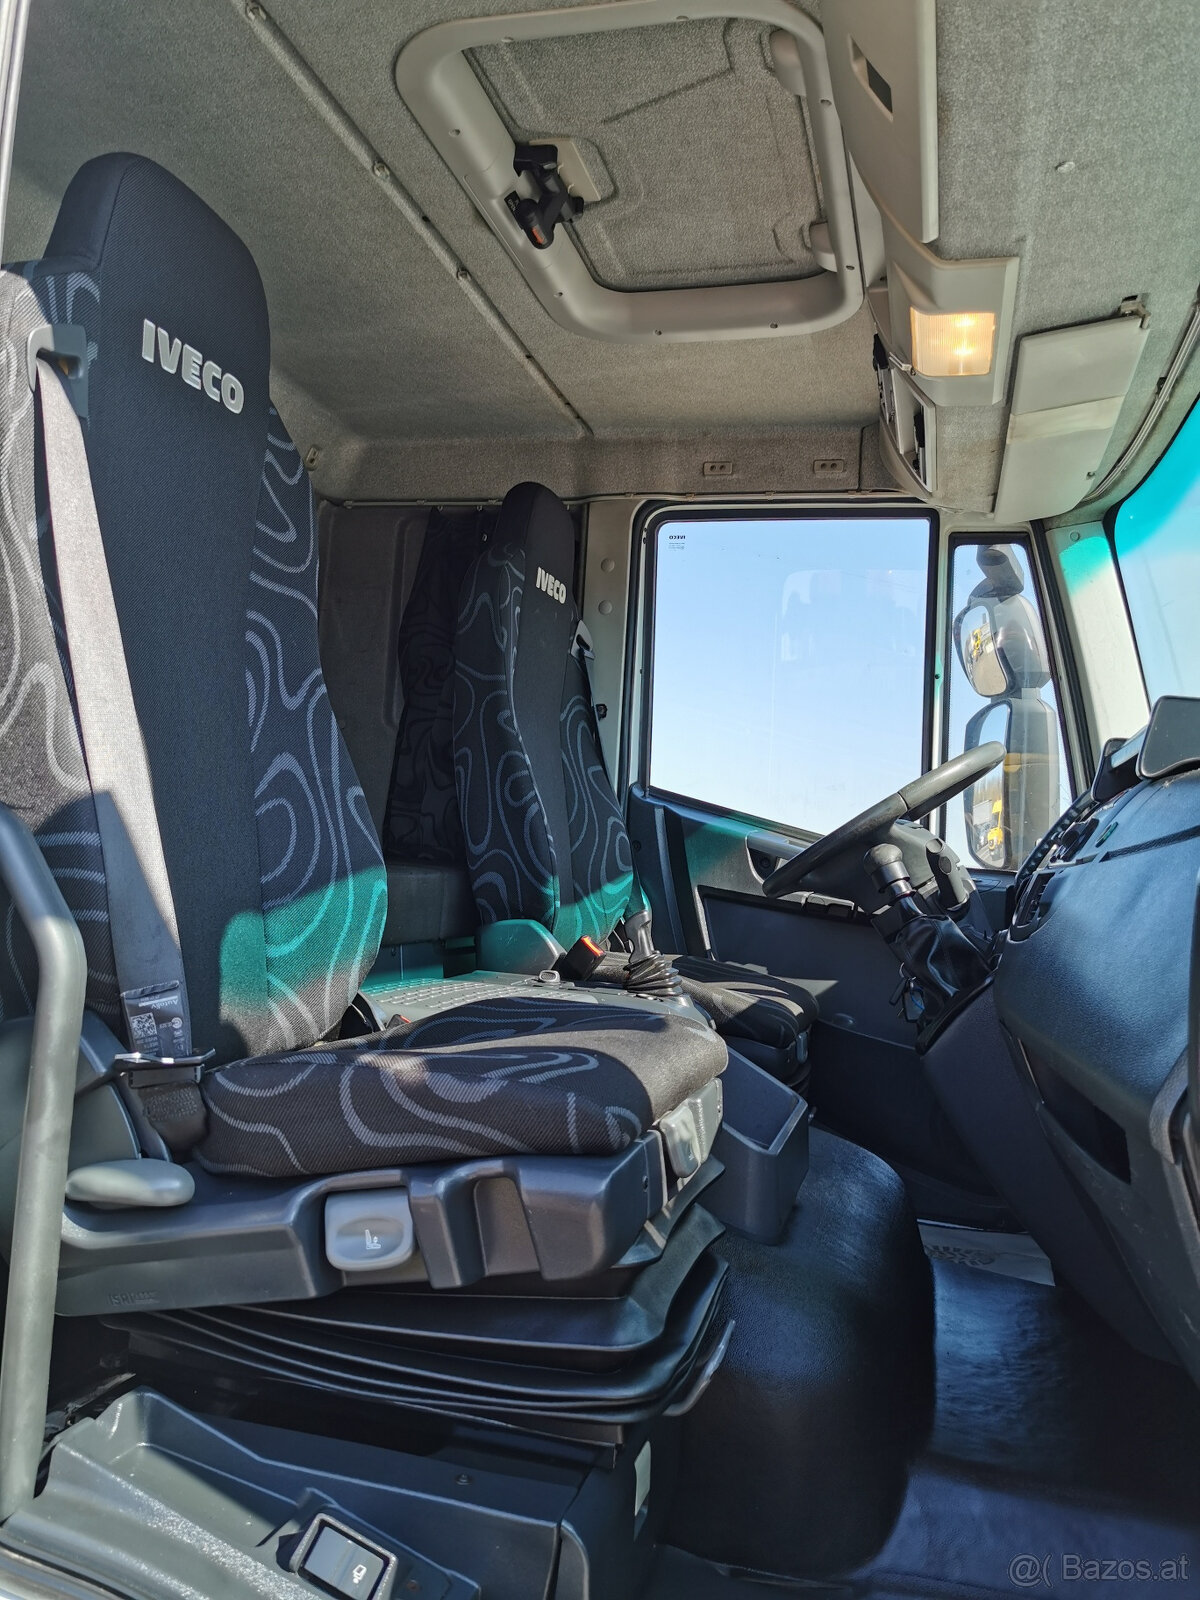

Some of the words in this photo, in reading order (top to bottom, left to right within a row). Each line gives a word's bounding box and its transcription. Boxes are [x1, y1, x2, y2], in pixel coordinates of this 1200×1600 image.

[141, 318, 245, 415] IVECO
[535, 566, 567, 604] IVECO
[151, 999, 179, 1010] Autoliv
